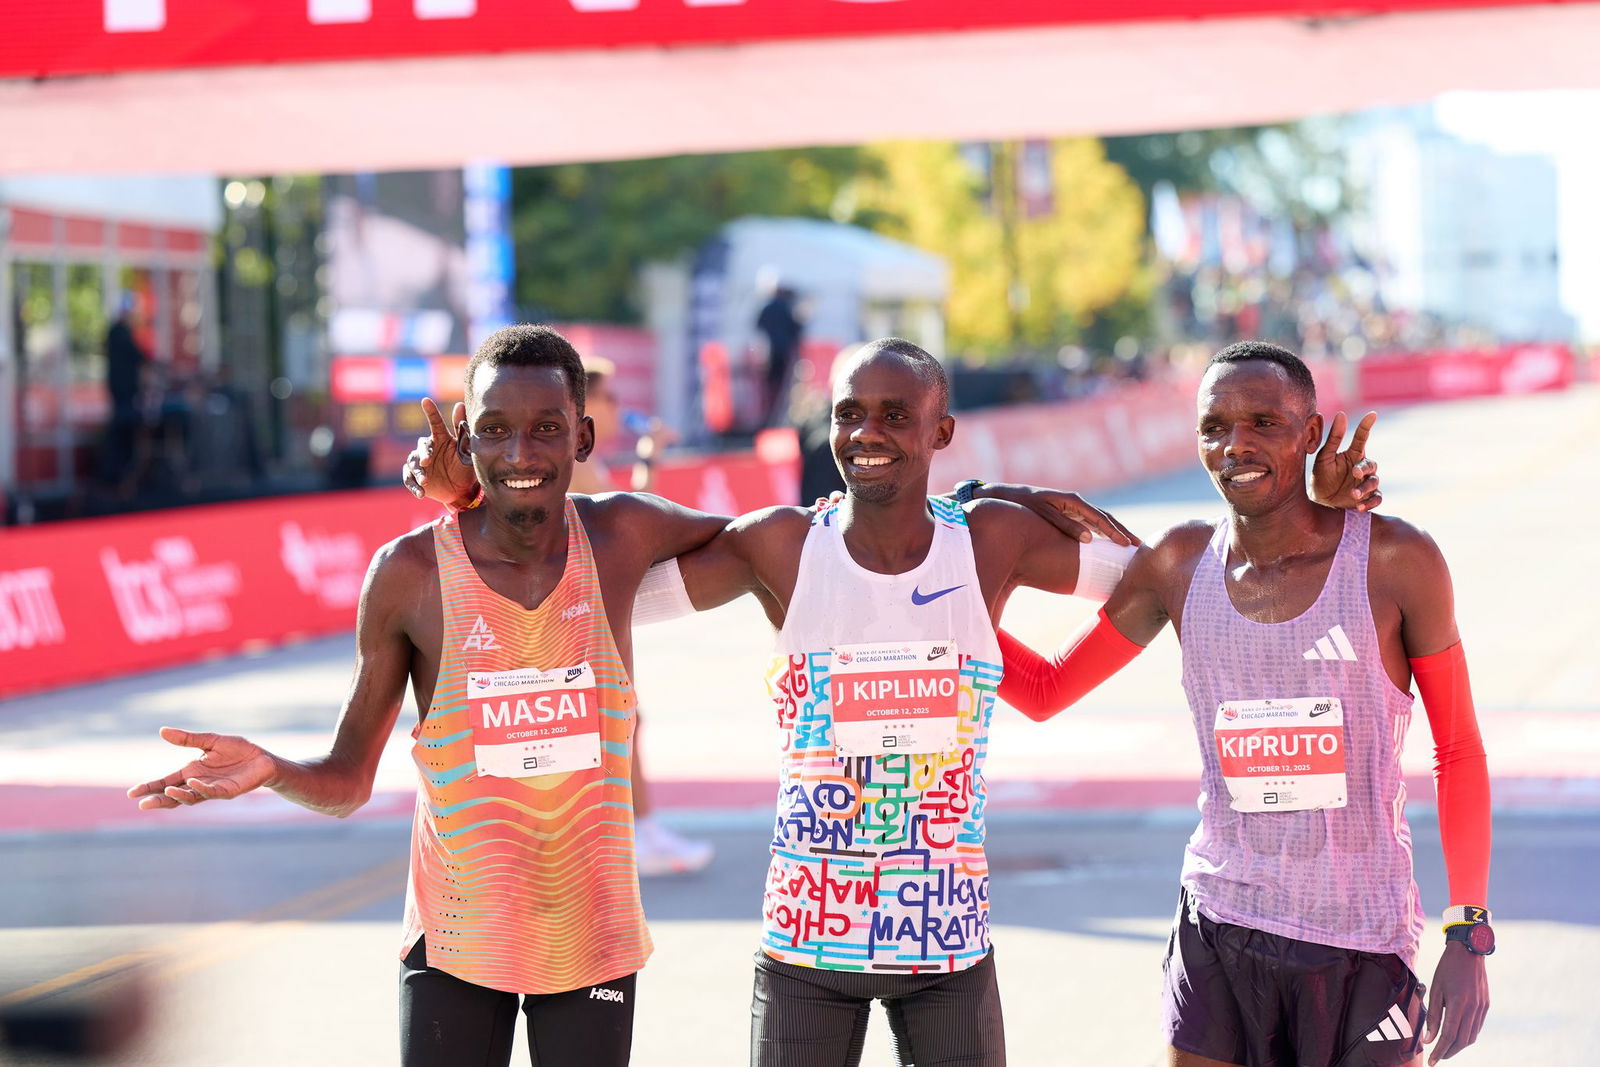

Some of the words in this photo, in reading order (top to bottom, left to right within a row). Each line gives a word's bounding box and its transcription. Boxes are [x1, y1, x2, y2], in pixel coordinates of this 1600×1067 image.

[561, 602, 591, 621] HOKA
[931, 646, 948, 655] RUN
[883, 654, 917, 662] MARATHON
[567, 667, 582, 676] RUN
[835, 682, 844, 706] J
[853, 677, 955, 701] KIPLIMO
[481, 692, 587, 728] MASAI
[866, 708, 899, 717] OCTOBER
[1314, 703, 1331, 712] RUN
[506, 728, 538, 739] OCTOBER
[540, 727, 550, 735] 12,
[551, 725, 567, 734] 2025
[1221, 733, 1338, 758] KIPRUTO
[1247, 765, 1280, 773] OCTOBER
[1294, 764, 1311, 772] 2025
[589, 987, 624, 1003] HOKA
